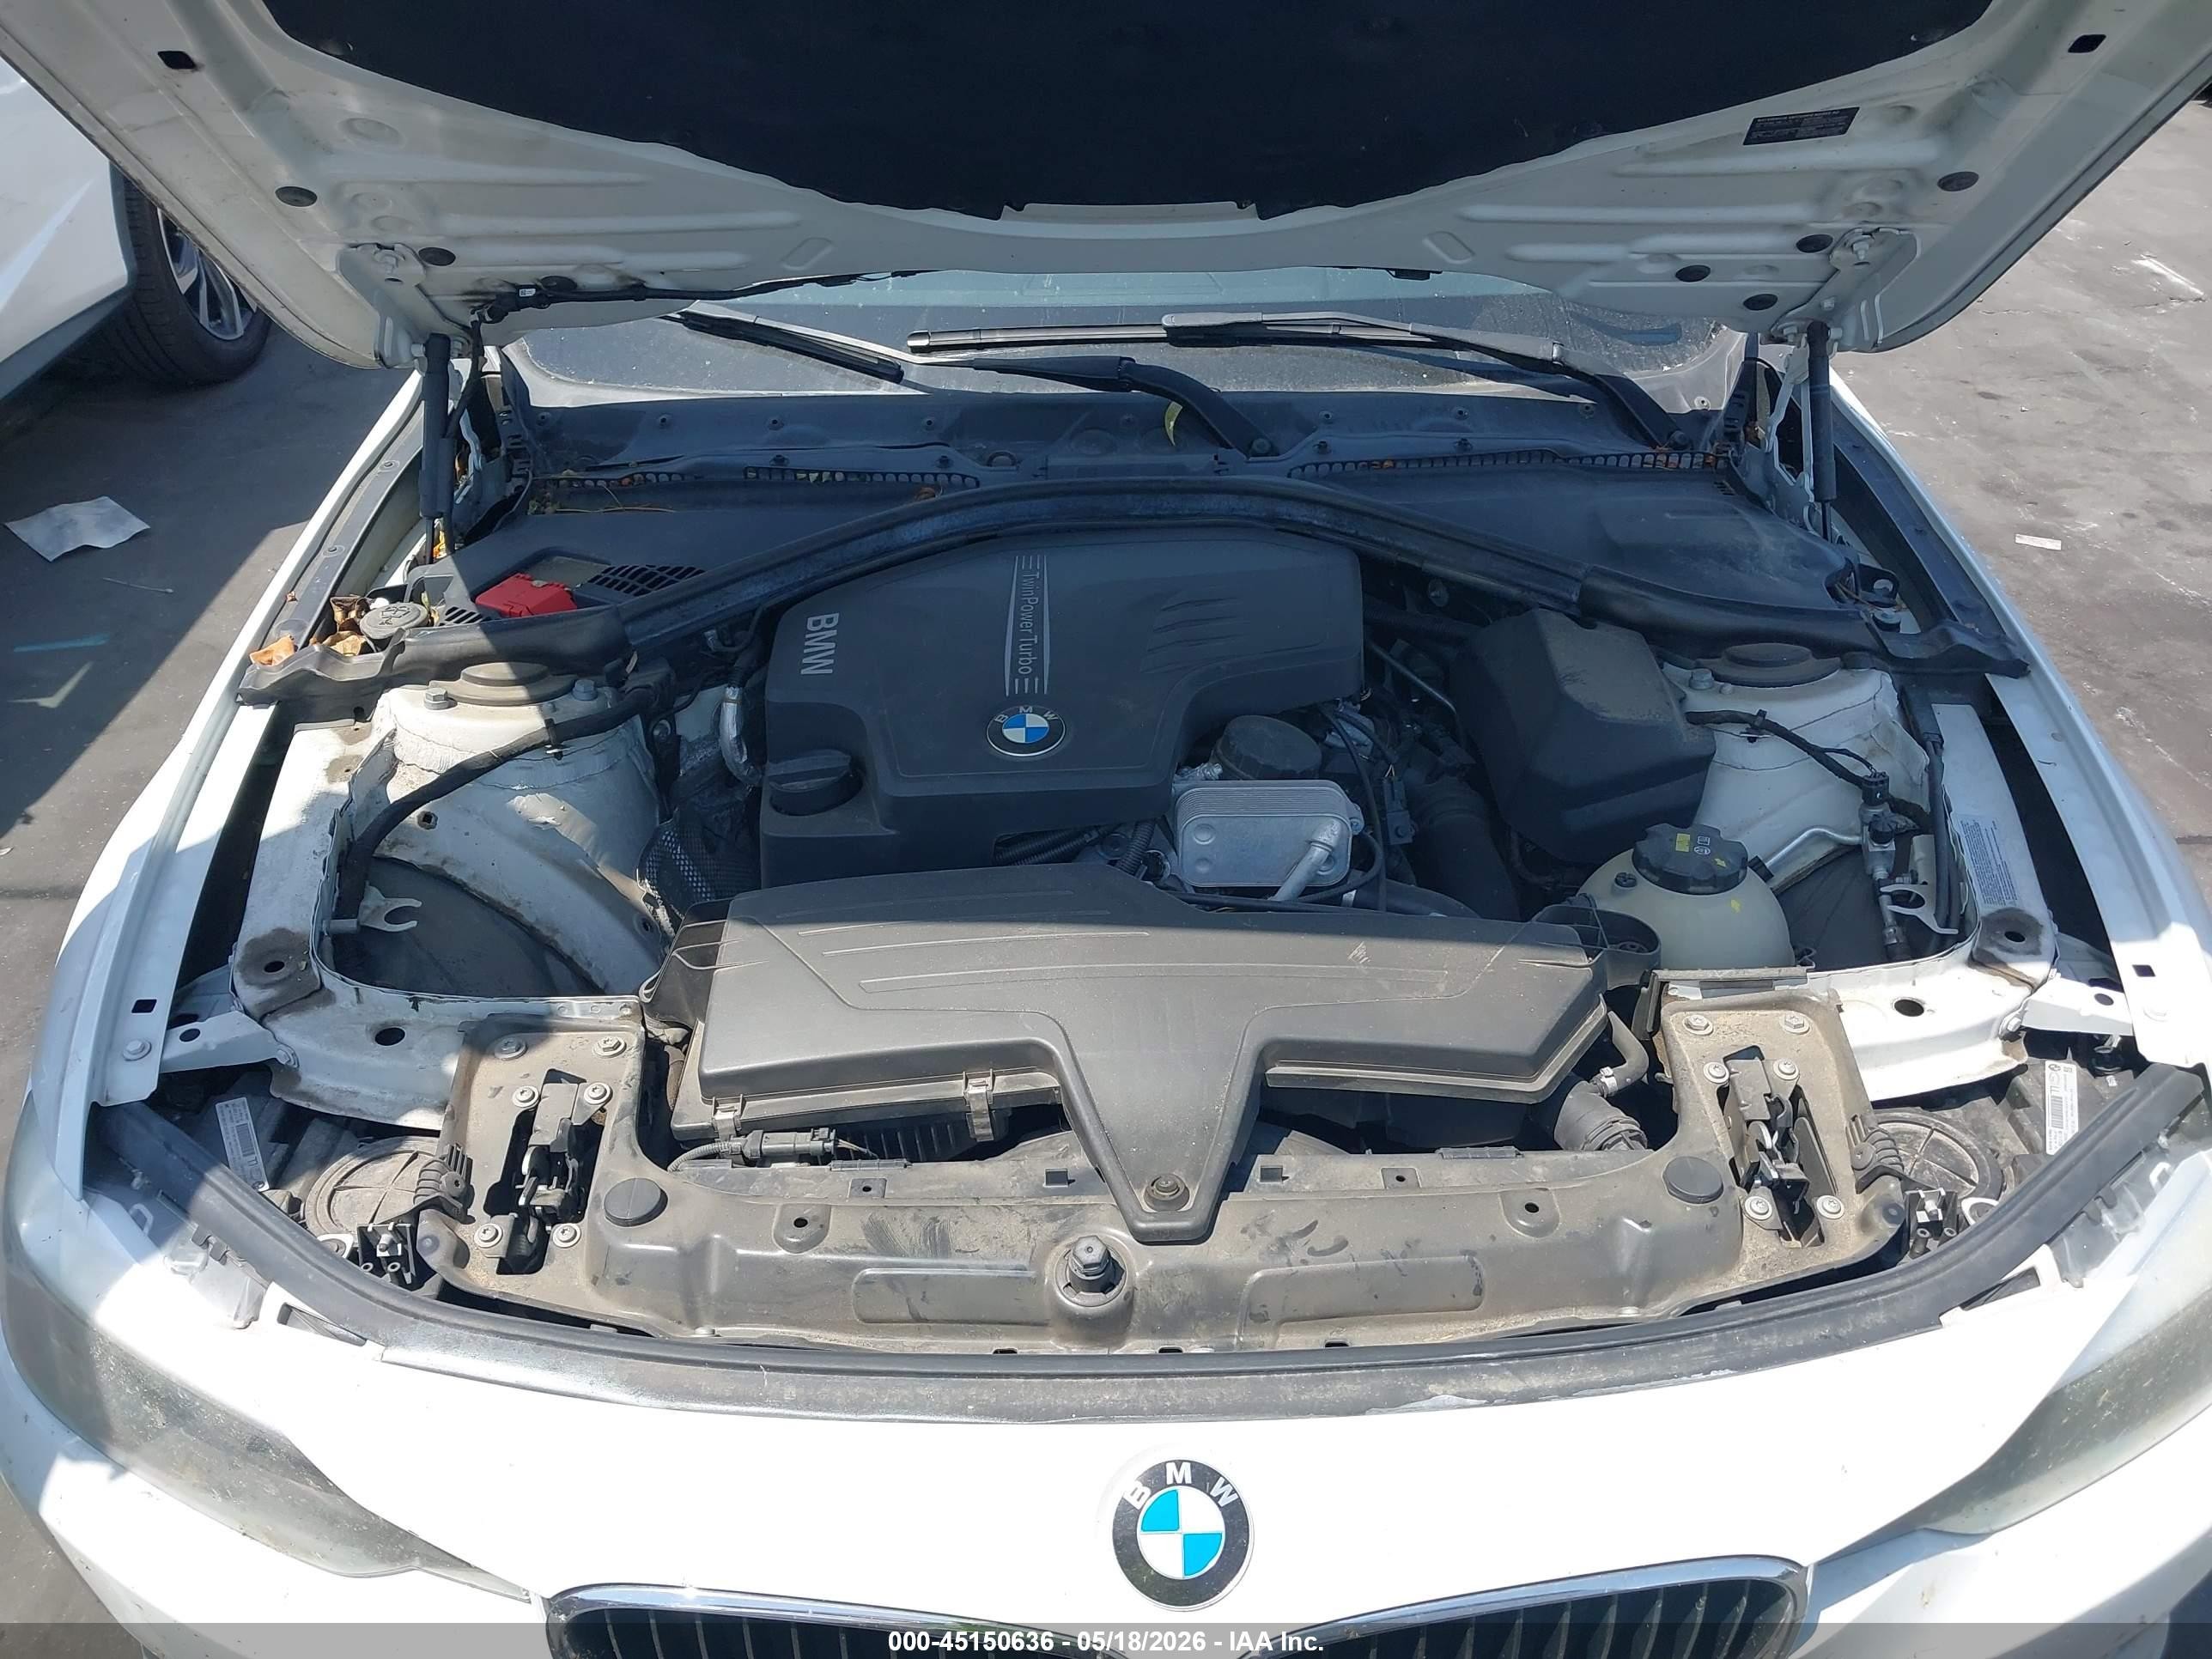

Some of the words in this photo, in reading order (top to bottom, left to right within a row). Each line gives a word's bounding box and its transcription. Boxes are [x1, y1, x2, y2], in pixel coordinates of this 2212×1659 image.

[1018, 571, 1040, 633] TwinPower
[800, 612, 840, 675] BMW
[1018, 635, 1038, 675] Turbo
[994, 705, 1058, 724] BMW
[1121, 1462, 1239, 1510] BMW
